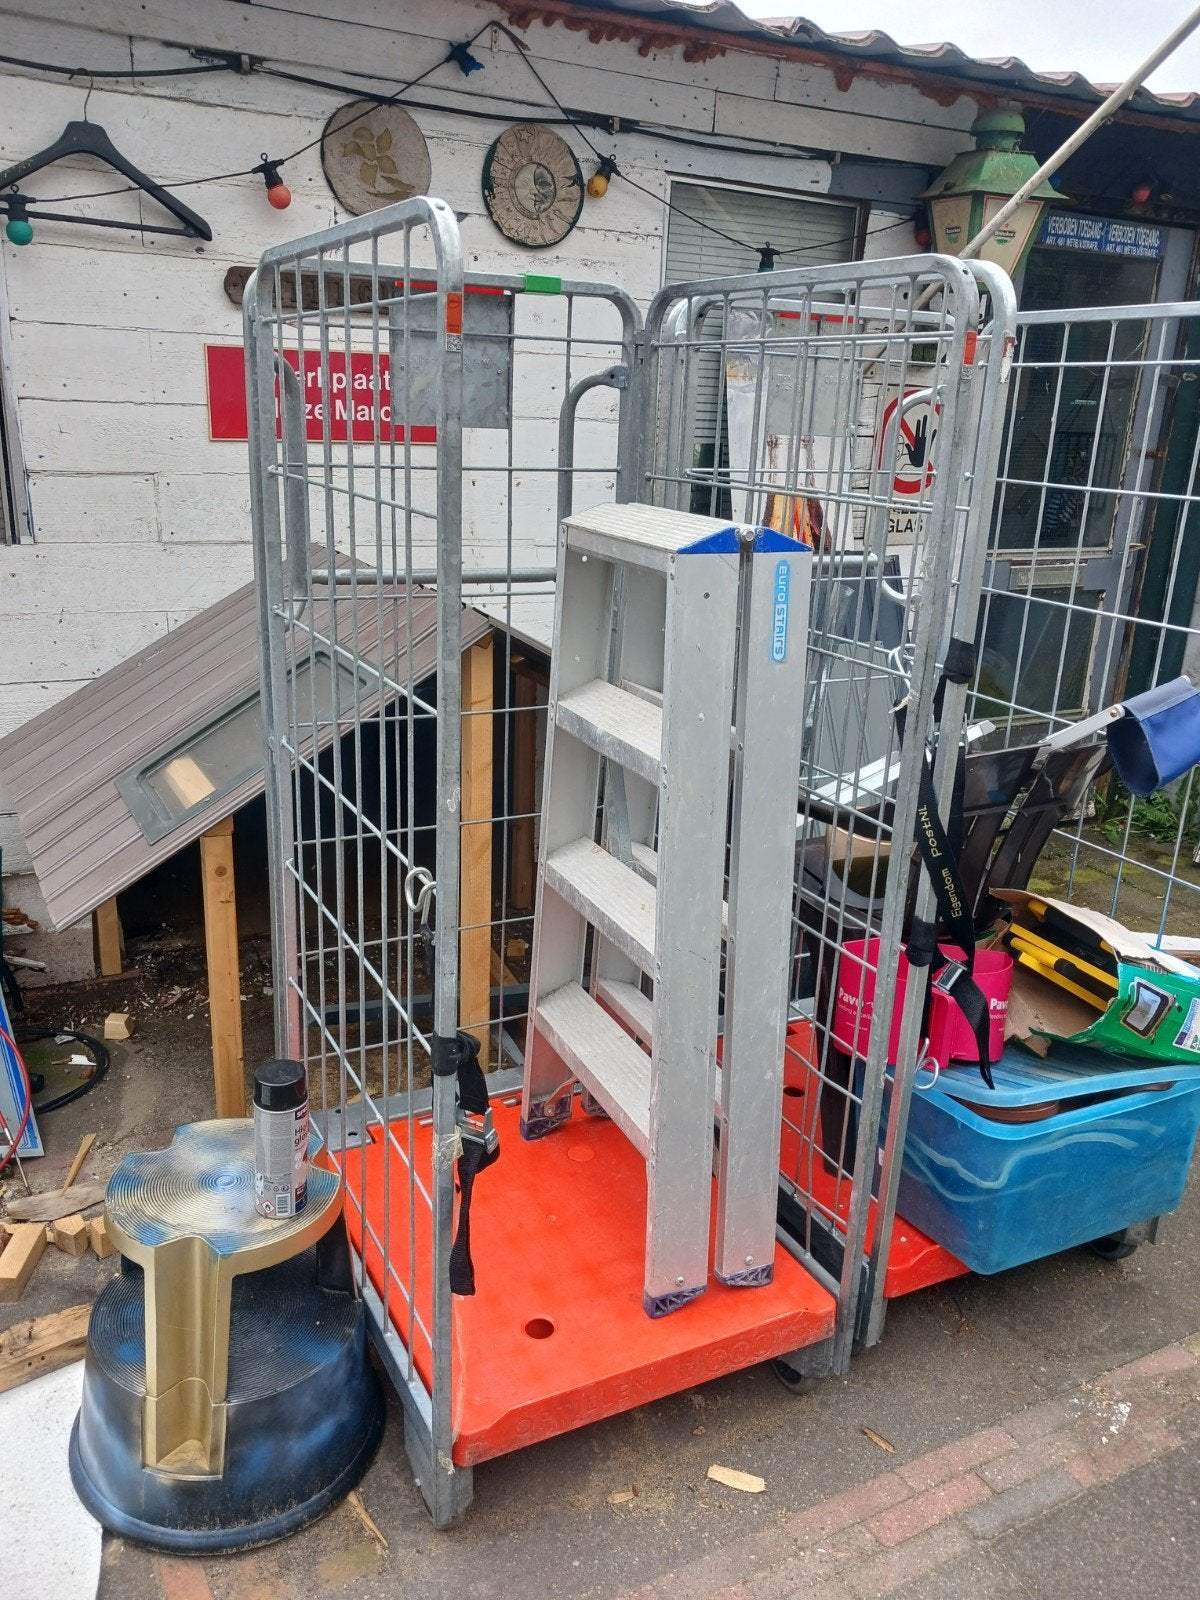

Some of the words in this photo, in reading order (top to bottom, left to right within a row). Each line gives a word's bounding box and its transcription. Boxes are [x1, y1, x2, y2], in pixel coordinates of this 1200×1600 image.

[1048, 216, 1078, 236] VERBODEN
[1078, 219, 1102, 239] TOEGANG
[1108, 223, 1136, 243] VERBODEN
[1135, 227, 1160, 247] TOEGANG
[941, 867, 962, 918] Eigendom
